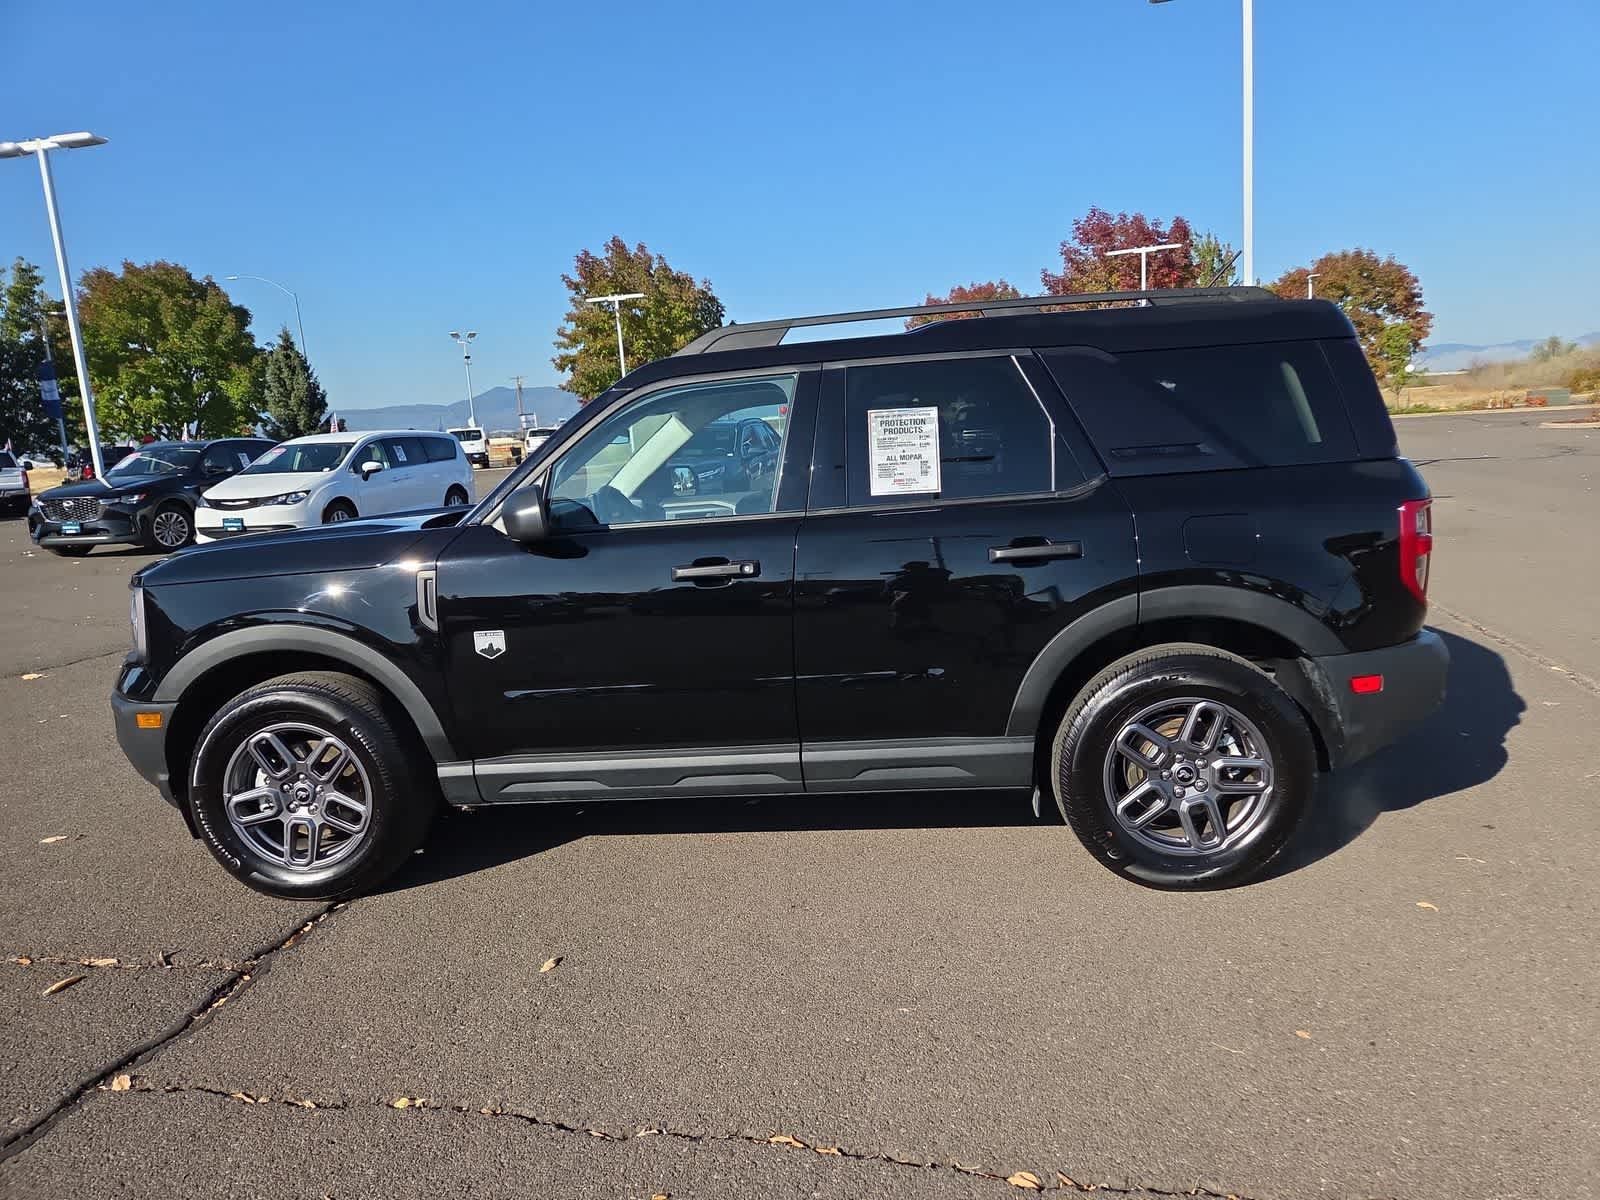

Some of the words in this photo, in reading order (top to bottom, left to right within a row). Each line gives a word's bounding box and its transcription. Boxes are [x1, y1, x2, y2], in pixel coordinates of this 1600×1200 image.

[879, 417, 926, 427] PROTECTION
[883, 426, 923, 435] PRODUCTS
[899, 453, 922, 461] MOPAR
